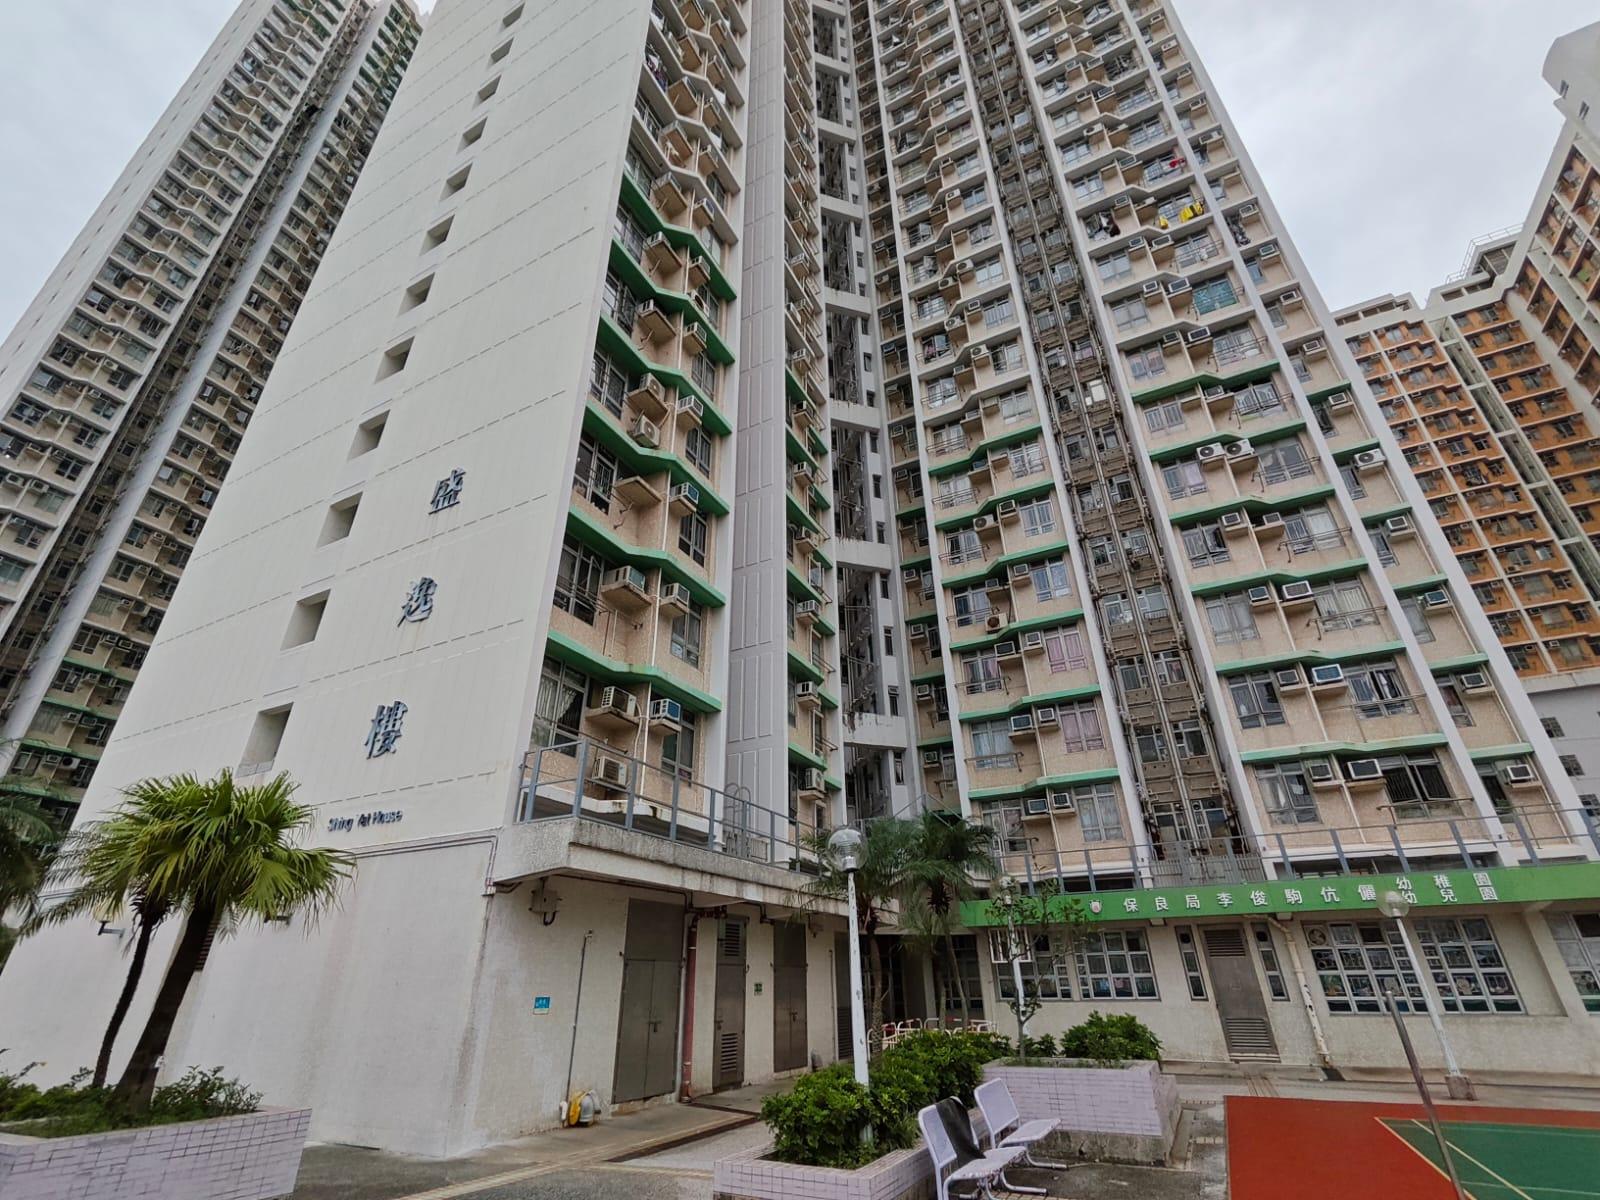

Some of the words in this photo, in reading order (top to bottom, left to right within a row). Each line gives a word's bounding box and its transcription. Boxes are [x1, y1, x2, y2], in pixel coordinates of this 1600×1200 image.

[364, 467, 466, 760] 盛逸樓
[328, 817, 354, 832] Shing
[372, 810, 403, 825] House
[1396, 872, 1492, 891] 幼稚園
